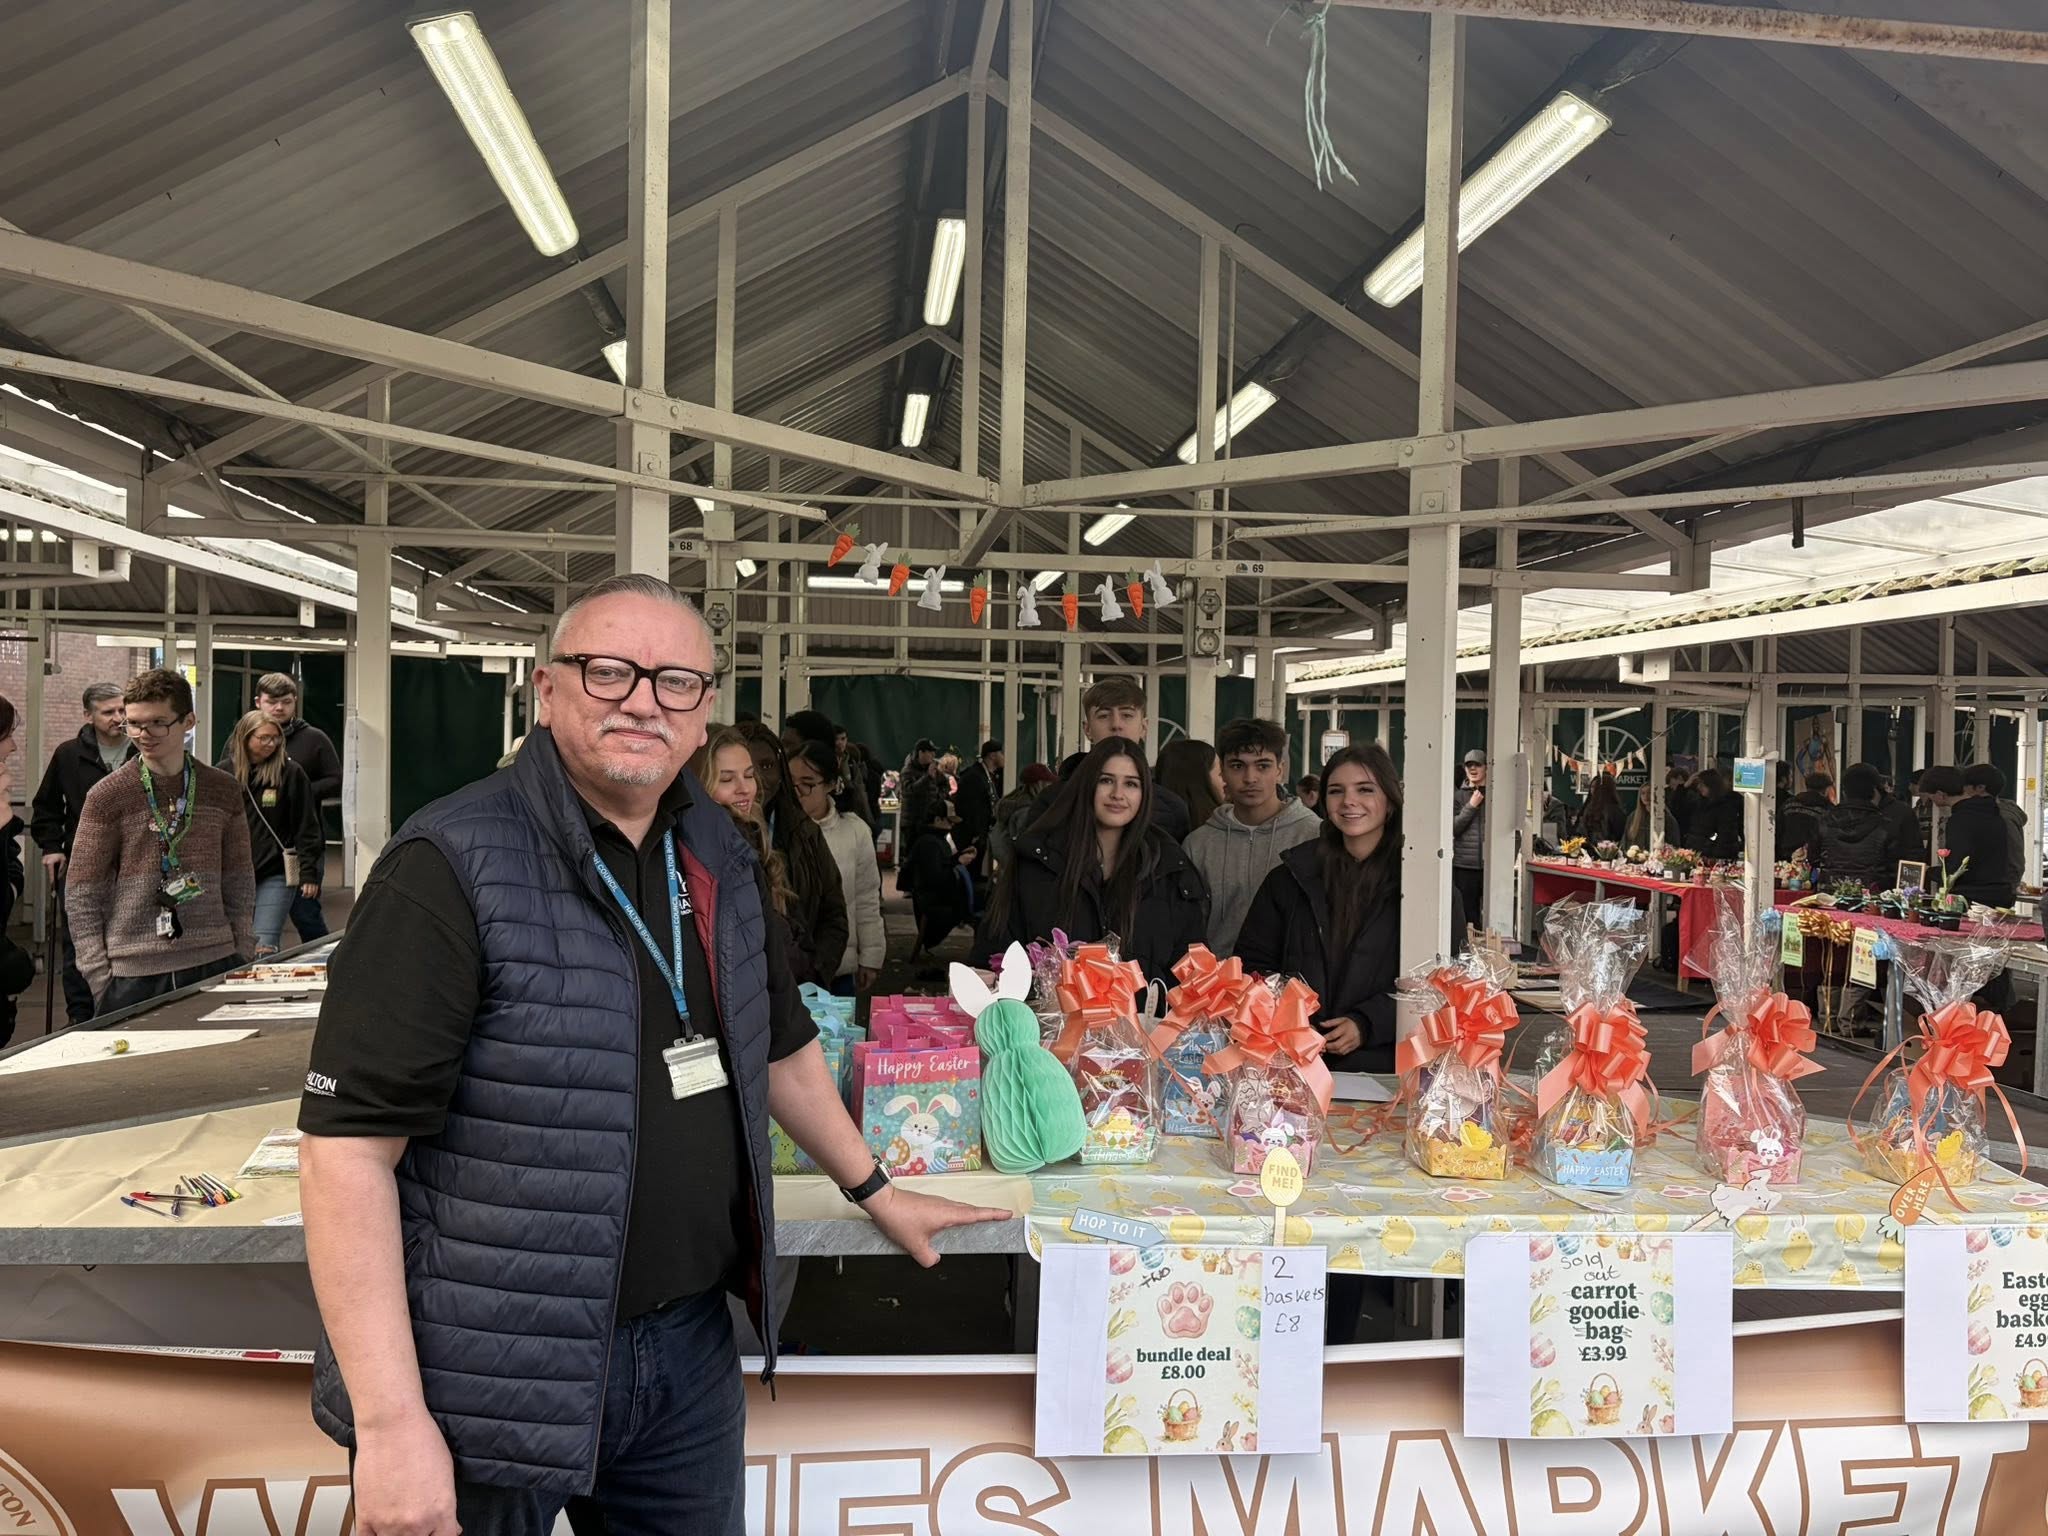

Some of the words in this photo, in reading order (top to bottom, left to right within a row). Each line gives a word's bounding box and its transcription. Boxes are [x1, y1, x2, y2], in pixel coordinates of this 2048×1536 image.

[680, 541, 693, 551] 68
[1252, 563, 1264, 573] 69
[1614, 775, 1648, 784] ARKET
[666, 854, 677, 880] HALTON
[598, 863, 619, 893] COUNCIL
[670, 896, 682, 925] COUNCIL
[624, 904, 643, 931] HALTON
[641, 929, 663, 961] BOROUGH
[878, 1057, 924, 1079] Happy
[929, 1055, 971, 1073] Easter
[1268, 1164, 1298, 1177] FIND
[1562, 1163, 1590, 1175] HAPPY
[1595, 1165, 1624, 1176] EASTER
[1272, 1177, 1294, 1189] ME!
[1895, 1186, 1917, 1218] OVER
[1912, 1180, 1931, 1212] HERE
[1079, 1214, 1107, 1230] HOP
[1112, 1221, 1129, 1235] TO
[1133, 1226, 1147, 1238] IT
[1271, 1255, 1294, 1279] 2
[1584, 1265, 1621, 1281] out
[2002, 1271, 2048, 1289] East
[1264, 1286, 1325, 1306] baskets
[1571, 1283, 1637, 1300] carrot
[1569, 1301, 1640, 1324] goodie
[1996, 1310, 2048, 1328] bask
[1275, 1312, 1301, 1333] £8
[1585, 1321, 1624, 1344] bag
[2015, 1332, 2048, 1348] £4.9
[1136, 1347, 1194, 1363] bundle
[1196, 1346, 1231, 1361] deal
[1581, 1346, 1627, 1361] £3.99
[1161, 1365, 1206, 1379] £8.00
